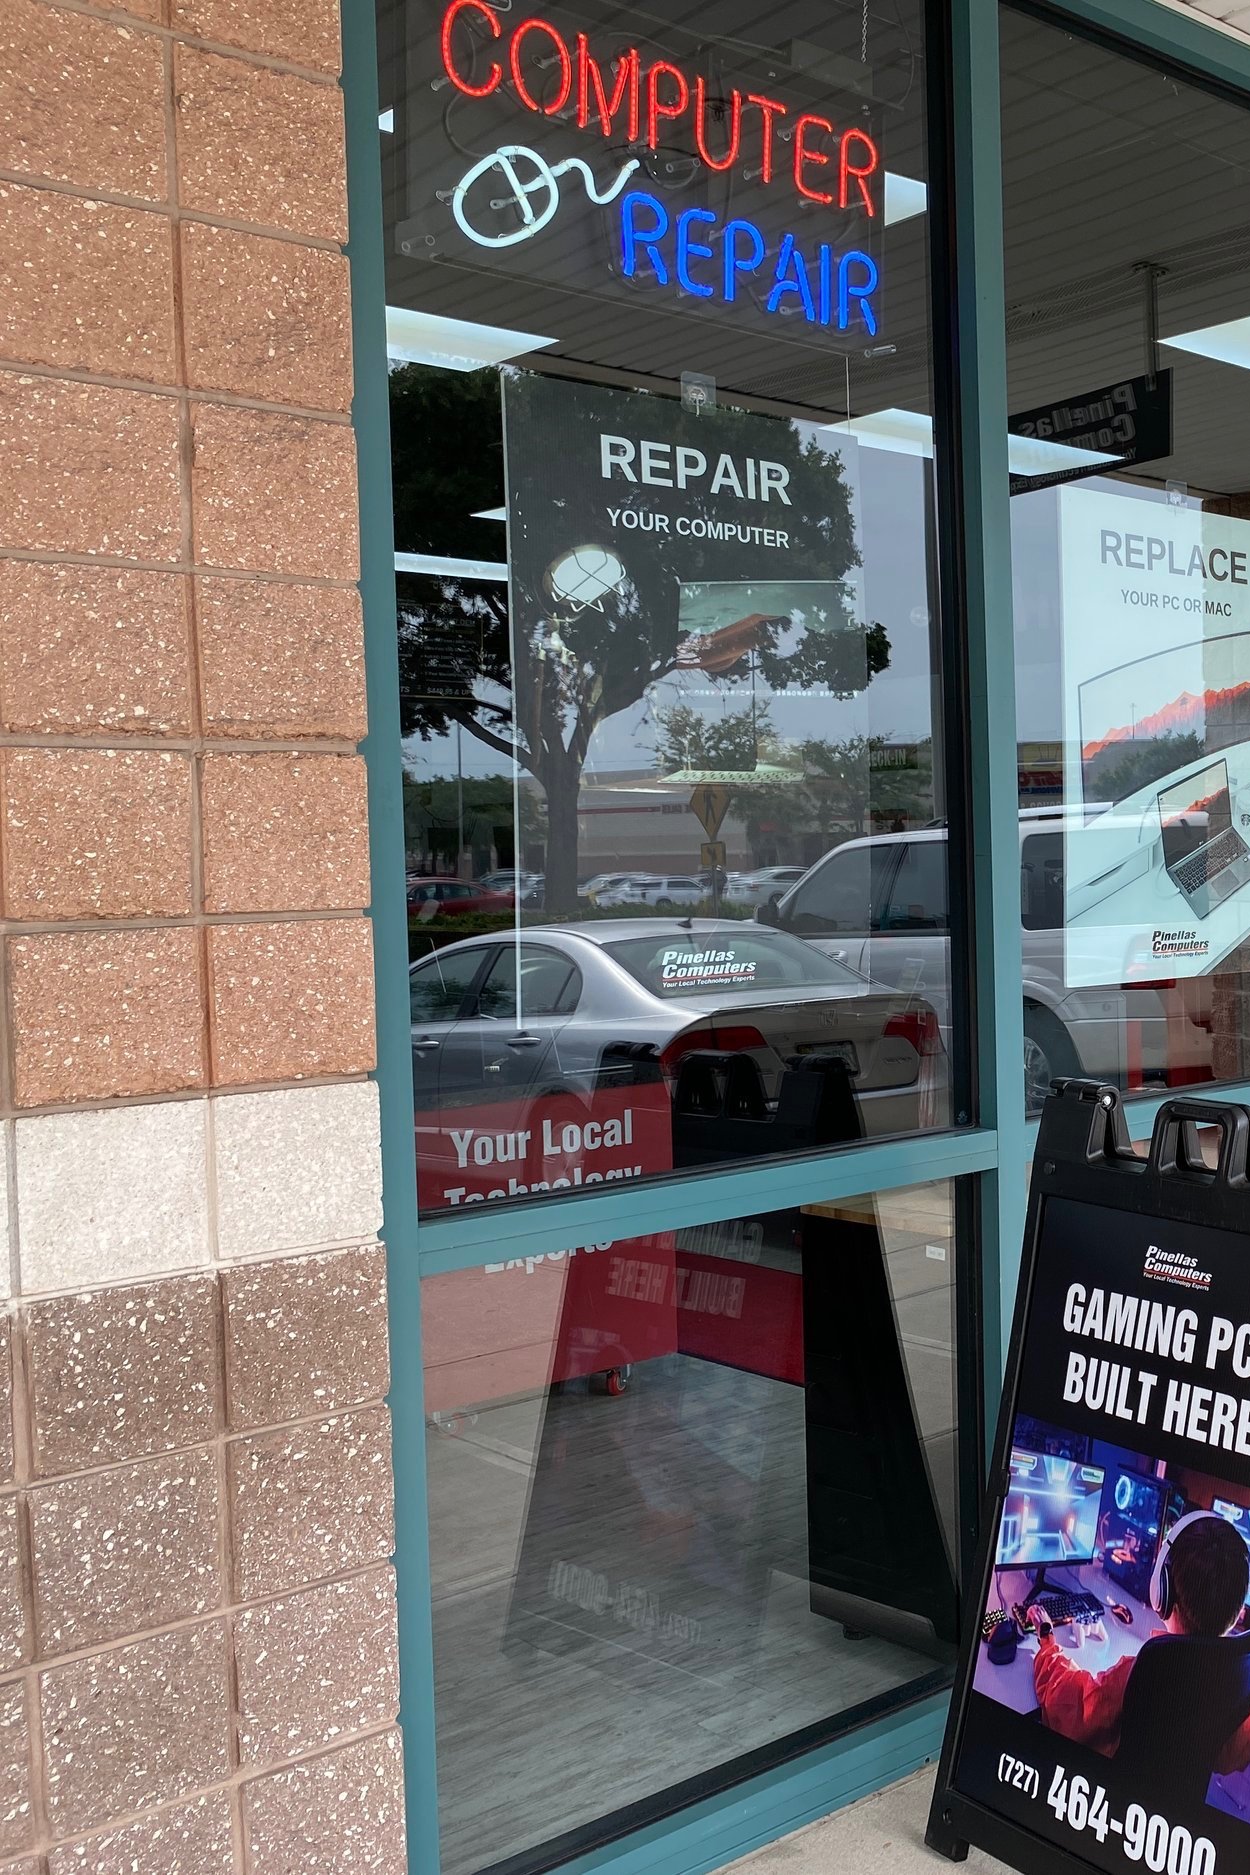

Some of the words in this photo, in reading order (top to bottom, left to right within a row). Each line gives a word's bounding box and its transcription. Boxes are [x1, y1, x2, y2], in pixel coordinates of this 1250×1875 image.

[441, 0, 878, 217] COMPUTER
[620, 190, 879, 337] REPAIR
[600, 433, 793, 506] REPAIR
[606, 507, 671, 535] YOUR
[675, 516, 791, 550] COMPUTER
[1100, 529, 1249, 586] REPLACE
[1120, 589, 1160, 609] YOUR
[1162, 594, 1181, 612] PC
[1183, 596, 1203, 614] OR
[1204, 600, 1233, 618] MAC
[1152, 930, 1196, 942] Pinellas
[1152, 940, 1209, 951] Computers
[661, 950, 735, 966] Pinellas
[662, 961, 757, 979] Computers
[697, 977, 731, 986] Technology
[732, 975, 755, 984] Experts
[450, 1129, 531, 1169] Your
[542, 1109, 633, 1156] Local
[1144, 1257, 1213, 1283] Computers
[1145, 1245, 1199, 1268] Pinellas
[1062, 1283, 1199, 1363] GAMING
[1062, 1351, 1158, 1425] BUILT
[997, 1752, 1041, 1799] (727)
[1047, 1765, 1217, 1875] 464-9000
